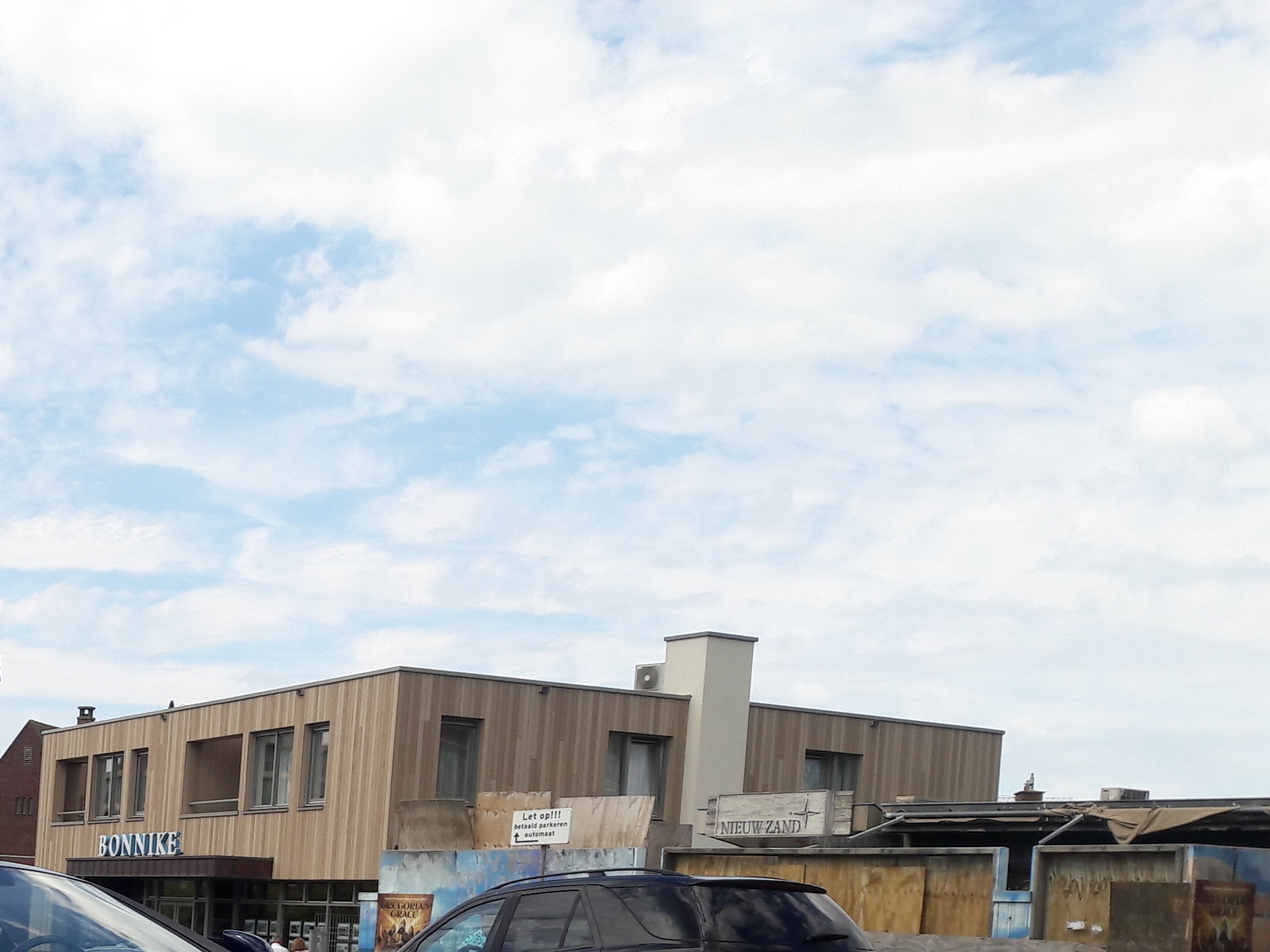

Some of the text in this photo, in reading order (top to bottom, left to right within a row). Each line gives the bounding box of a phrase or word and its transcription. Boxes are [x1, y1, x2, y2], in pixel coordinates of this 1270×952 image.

[522, 810, 561, 820] Let op!!!
[98, 831, 182, 857] BONNIKE
